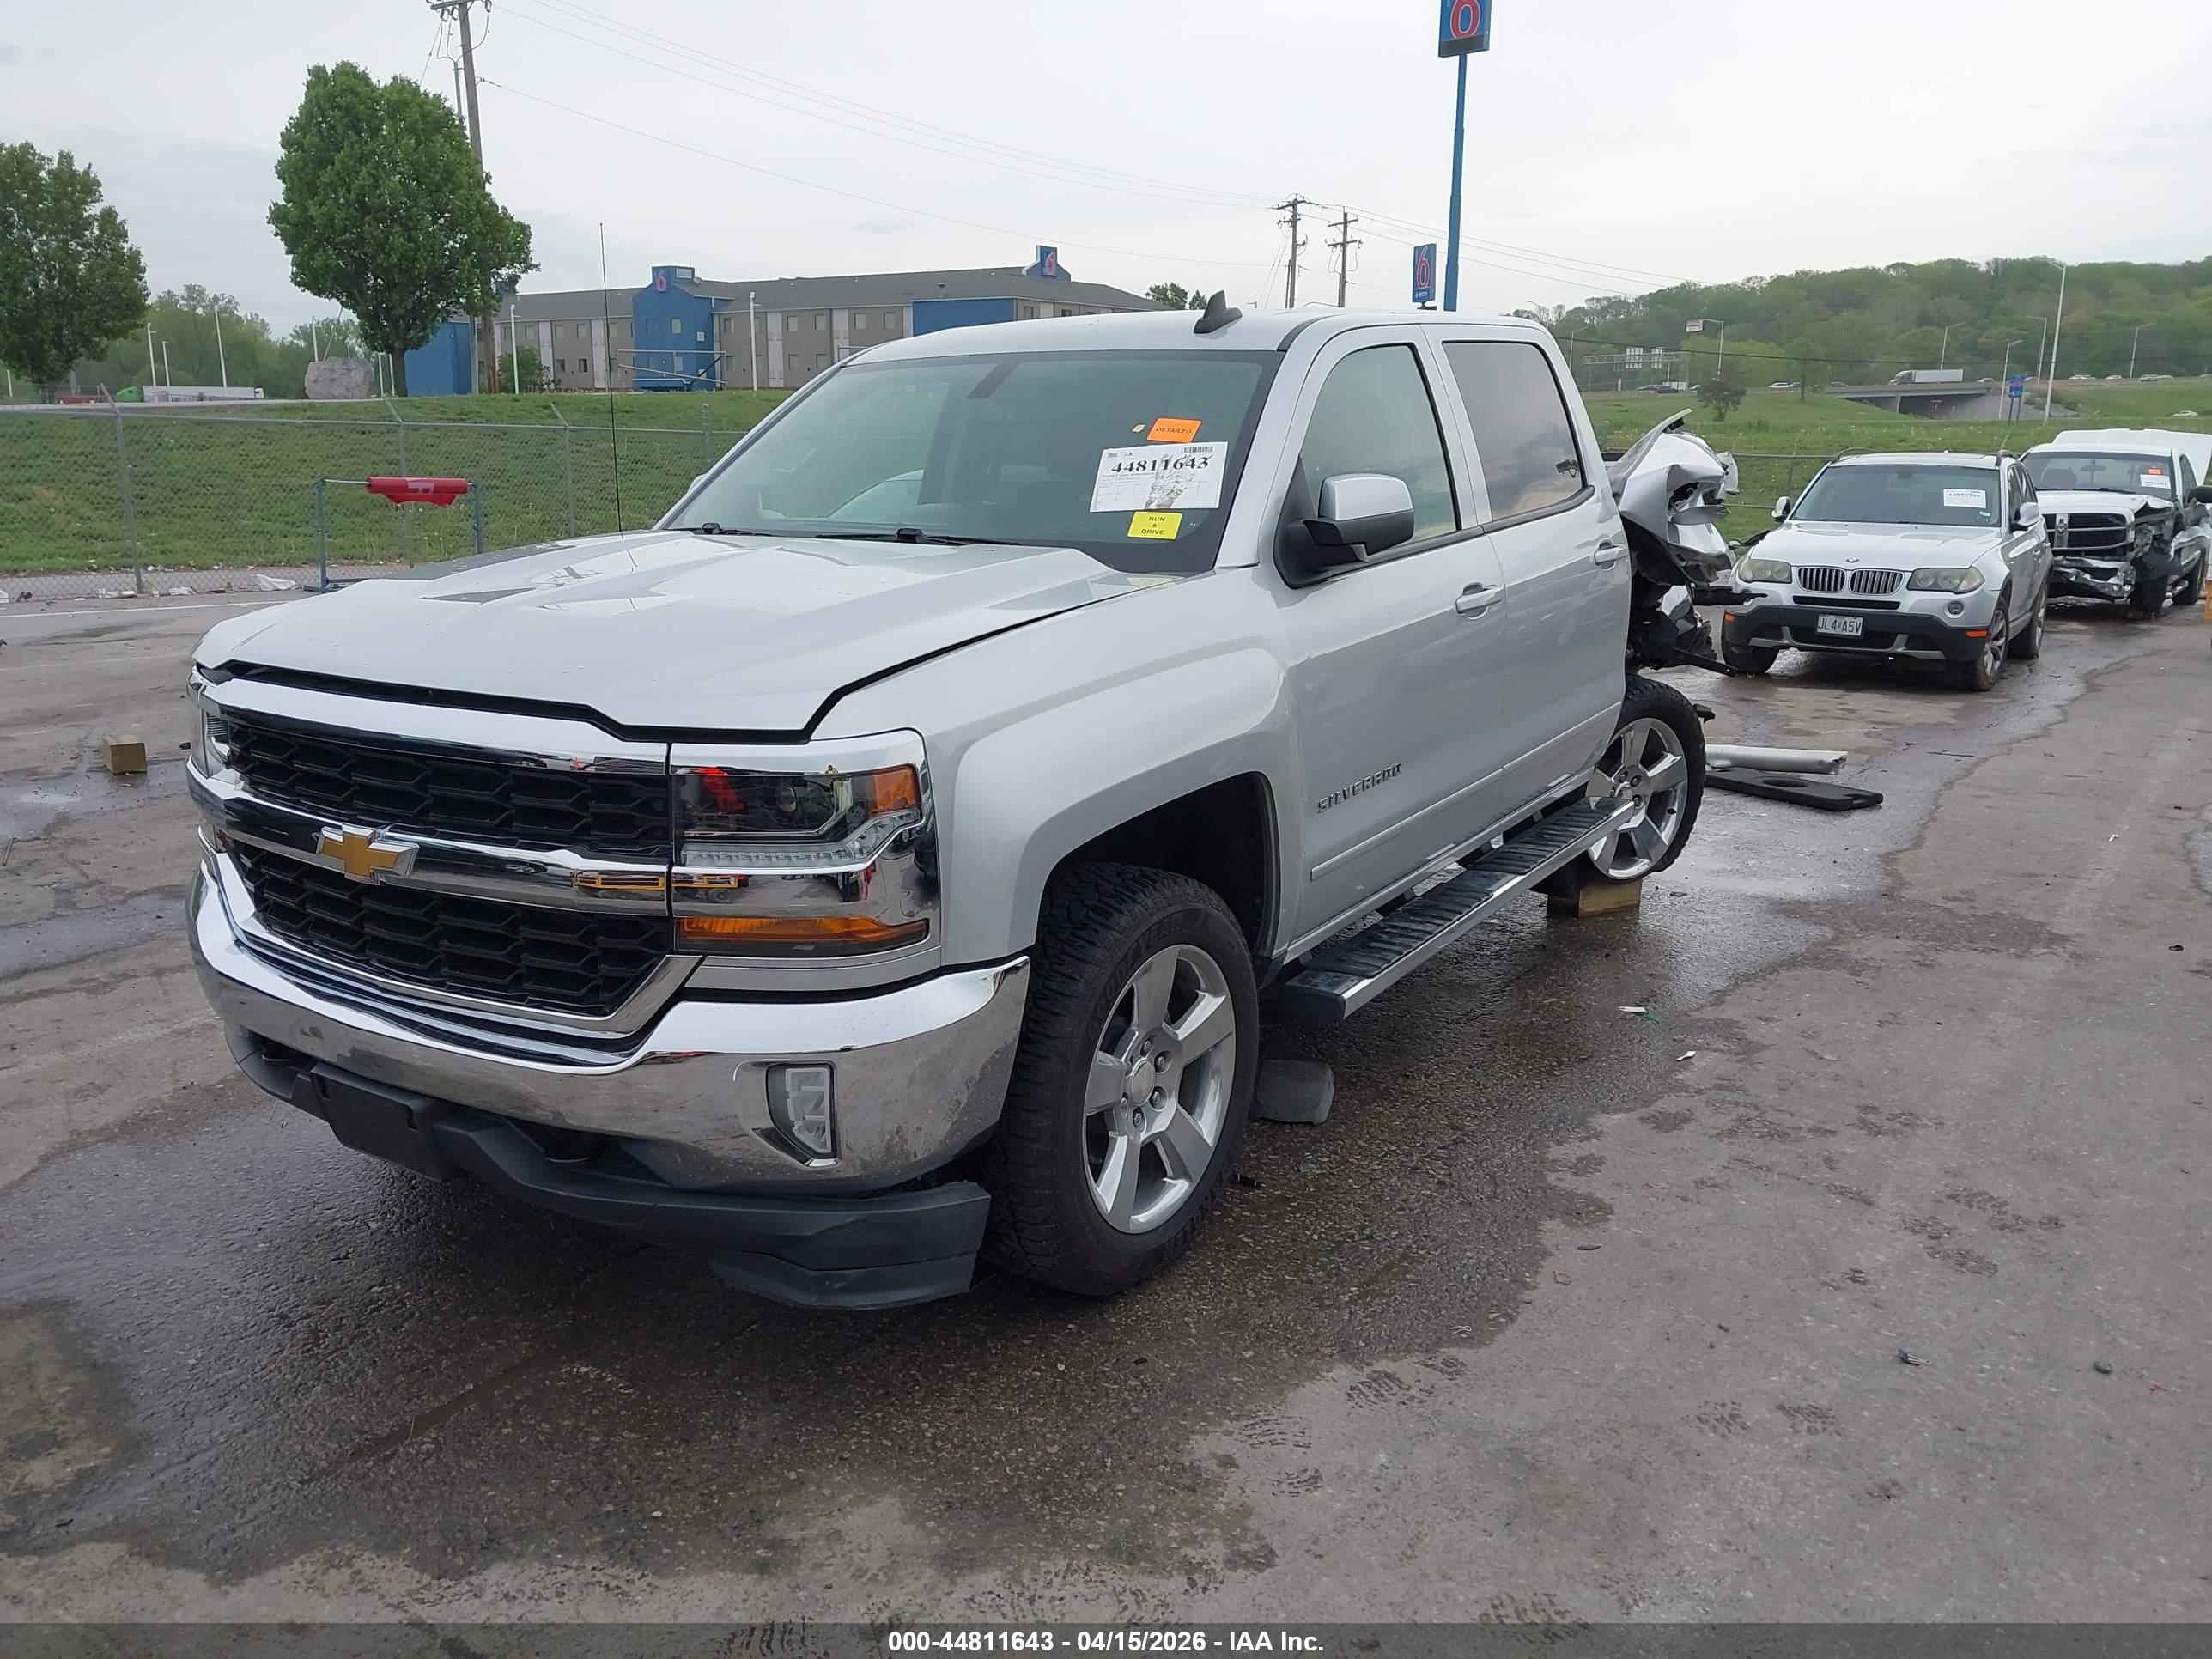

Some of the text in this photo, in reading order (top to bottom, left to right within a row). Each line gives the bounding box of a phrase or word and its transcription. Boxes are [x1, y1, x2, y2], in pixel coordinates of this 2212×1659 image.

[1045, 252, 1057, 276] 6
[1417, 246, 1430, 289] 6
[656, 270, 667, 292] 6
[1111, 455, 1210, 473] 44811643
[1817, 617, 1863, 634] JL4 A5V
[1317, 762, 1402, 813] SILVERADO
